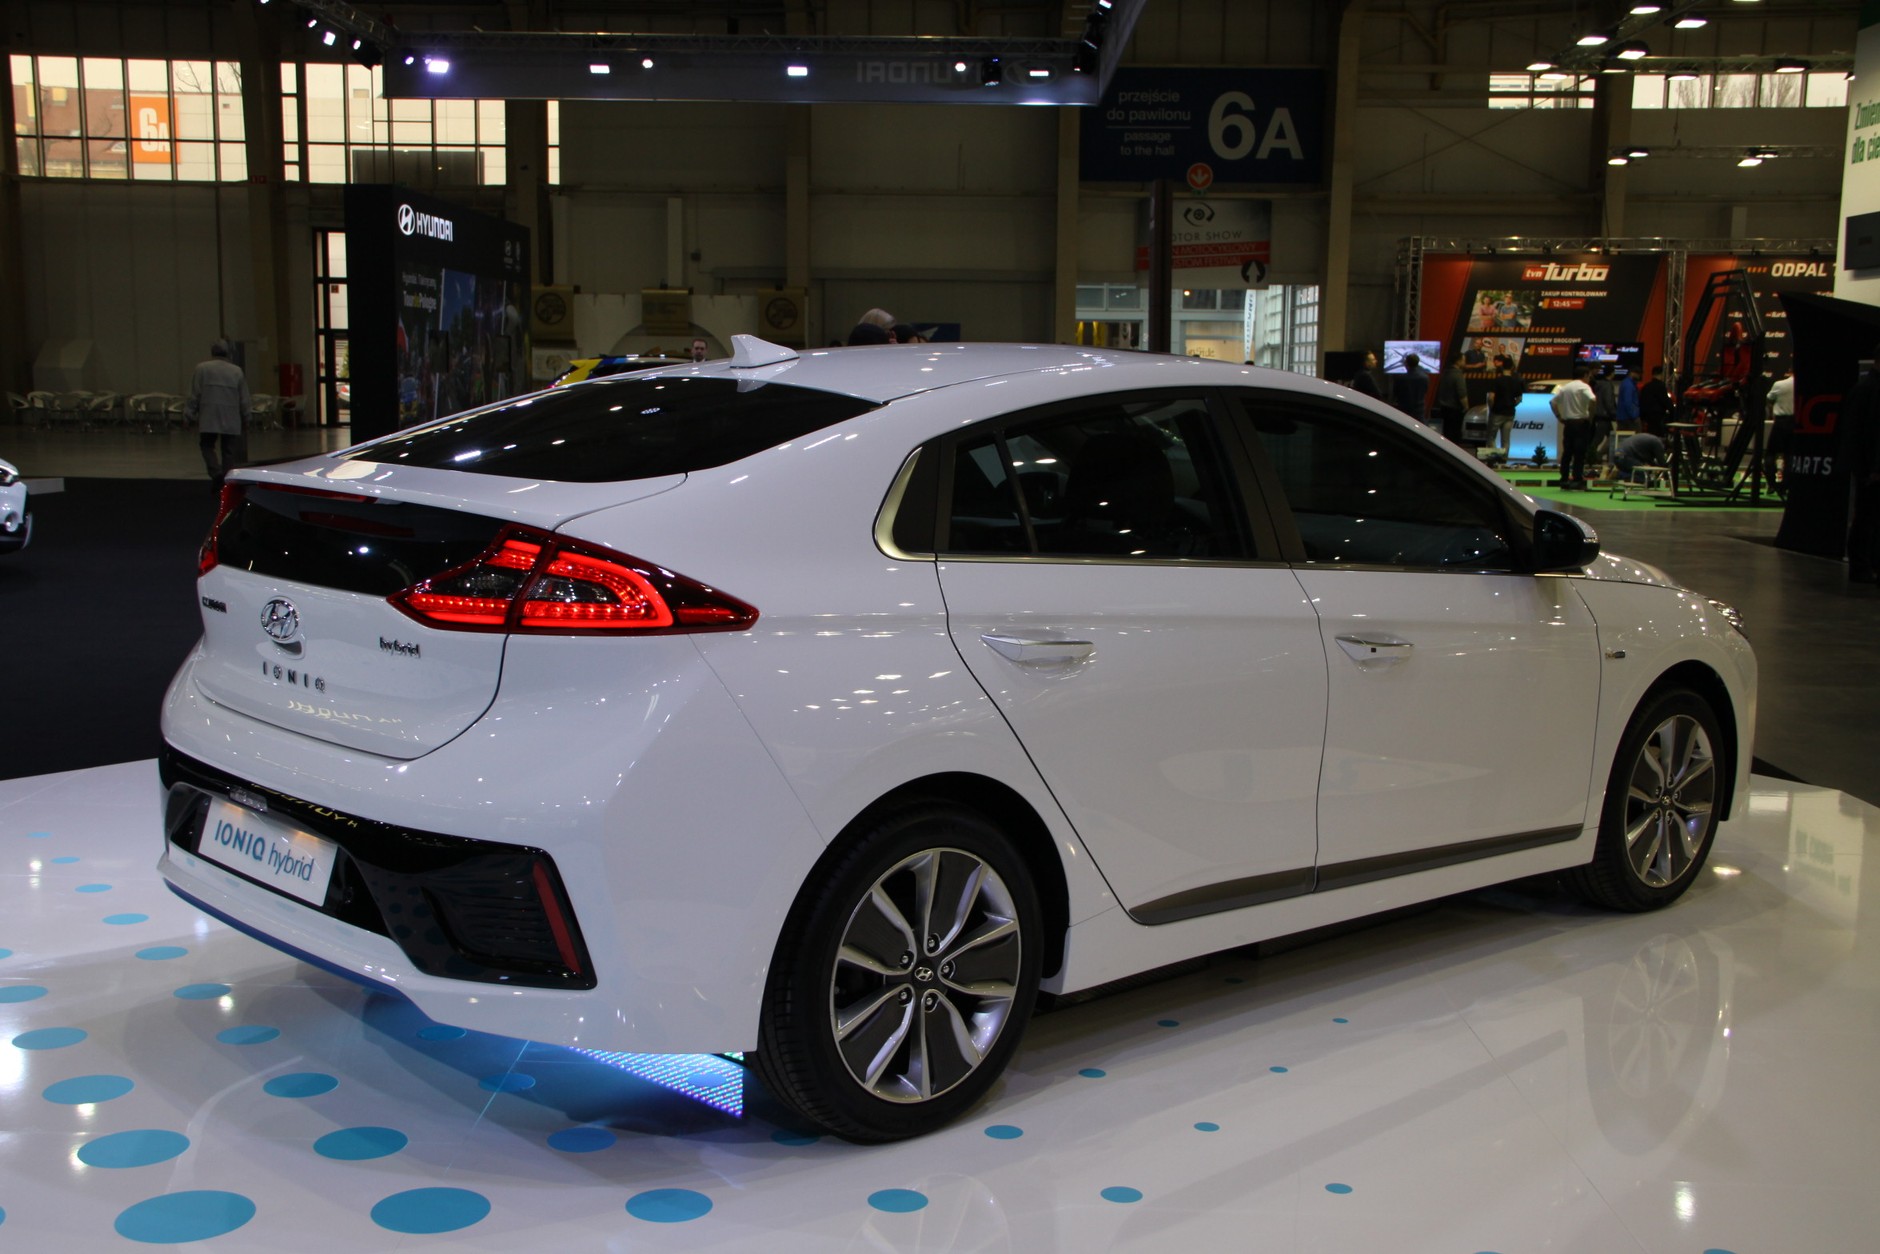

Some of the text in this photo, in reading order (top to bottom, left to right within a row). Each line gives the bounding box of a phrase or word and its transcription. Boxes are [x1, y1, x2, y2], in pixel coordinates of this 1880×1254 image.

[1118, 88, 1180, 105] przejście
[1106, 108, 1191, 124] do pawilonu
[139, 107, 172, 152] 6A
[1207, 90, 1305, 161] 6A
[1123, 131, 1172, 143] passage
[1120, 144, 1175, 156] to the hall
[416, 211, 454, 242] HYUNDAI
[1206, 230, 1242, 241] SHOW
[1181, 243, 1257, 255] MOTOCYKLOWY
[1204, 256, 1241, 266] FESTIVAL
[1525, 269, 1543, 278] tvn
[1771, 262, 1828, 278] ODPAL
[1552, 300, 1571, 308] 12:45
[379, 636, 422, 659] hybrid
[262, 661, 326, 693] IONIQ
[214, 819, 315, 882] IONIQ hybrid
